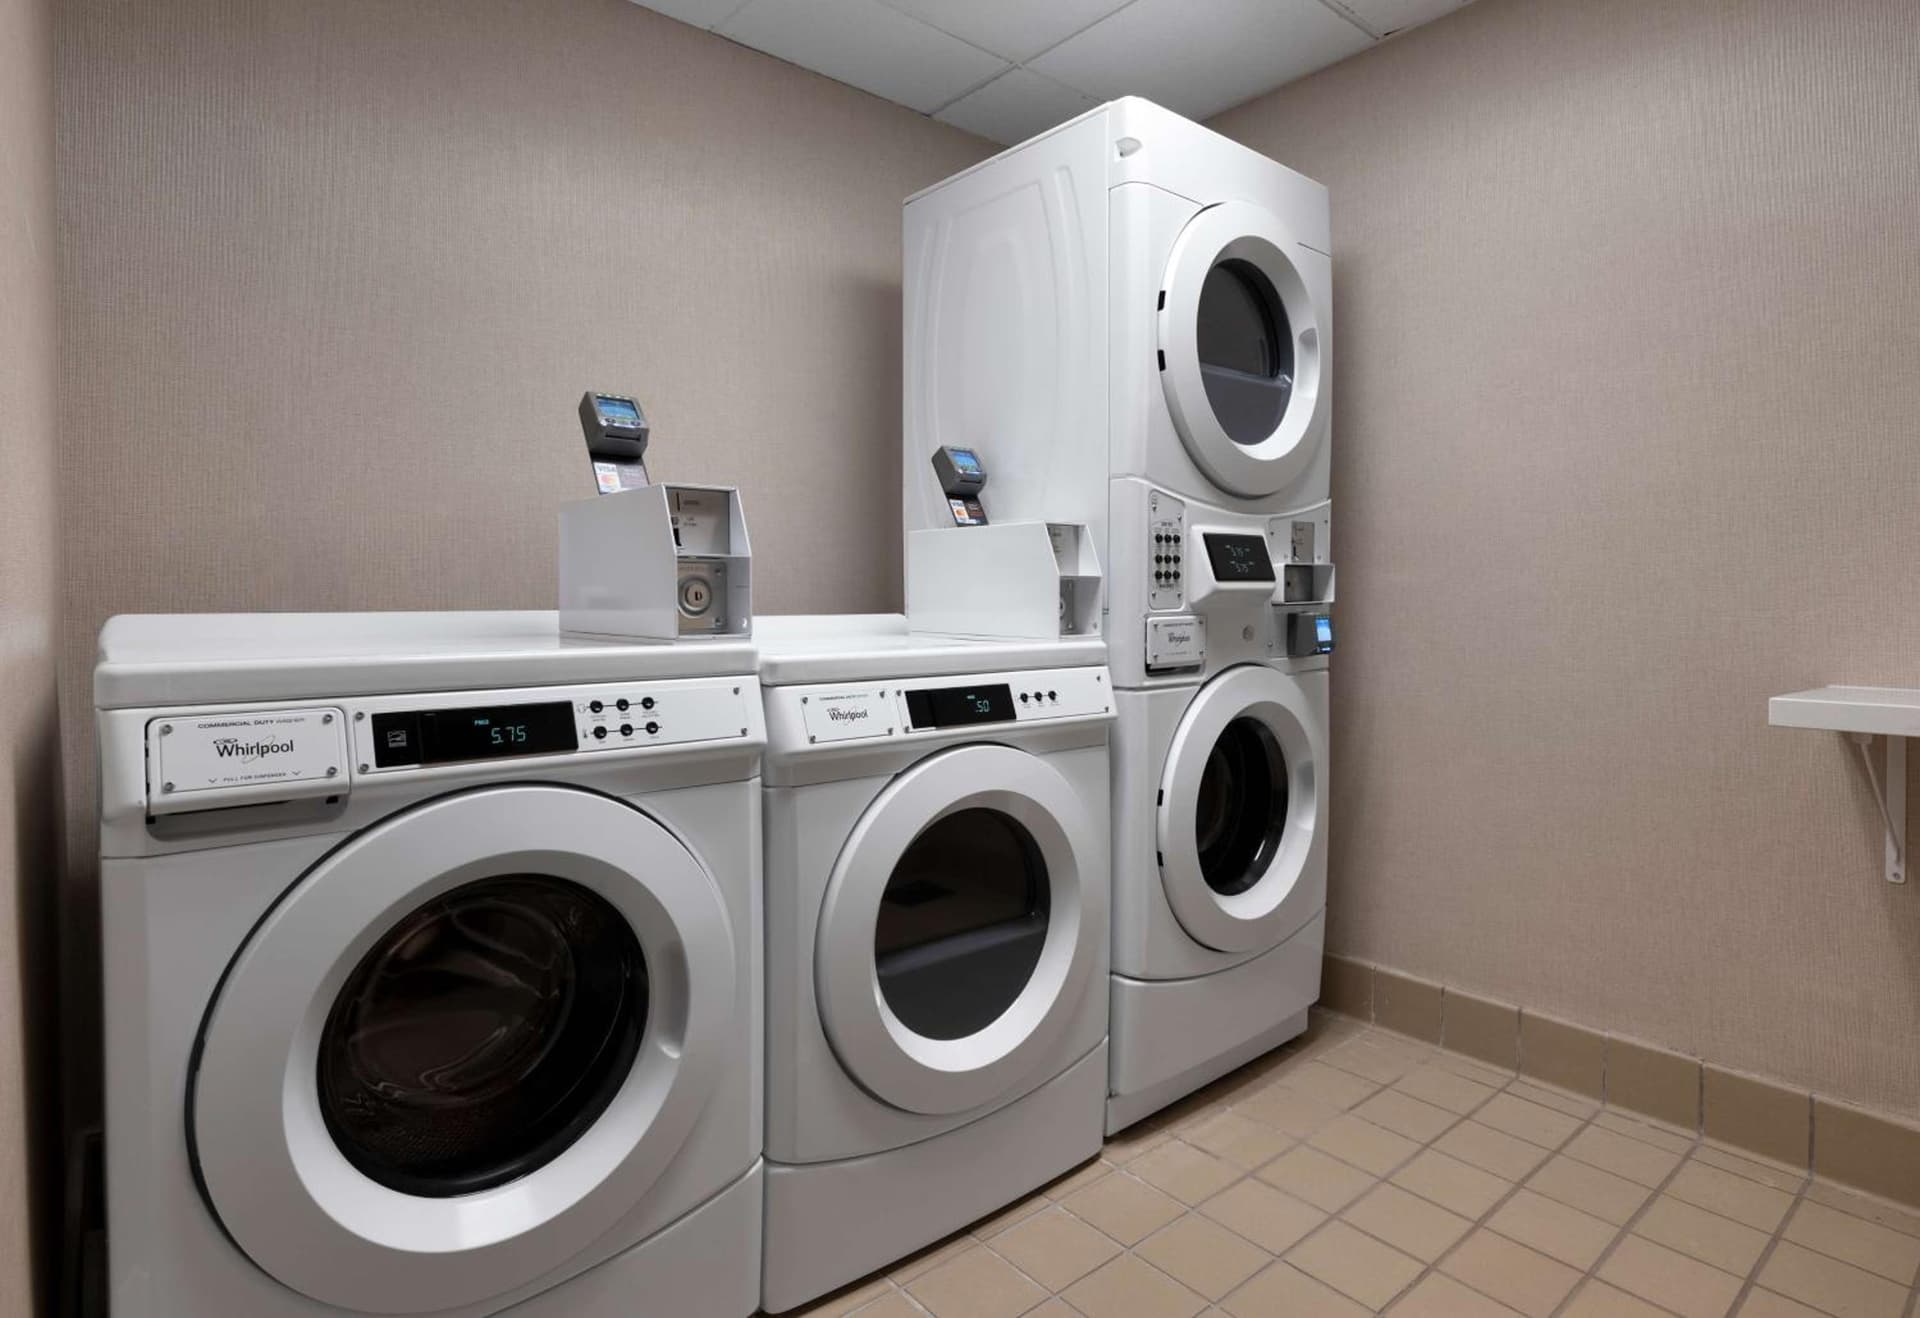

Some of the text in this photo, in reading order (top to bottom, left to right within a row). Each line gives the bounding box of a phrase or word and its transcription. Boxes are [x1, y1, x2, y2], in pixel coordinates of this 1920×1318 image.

[829, 709, 868, 722] Whirlpool
[197, 721, 251, 729] COMMERCIAL
[216, 739, 294, 758] Whirlpool
